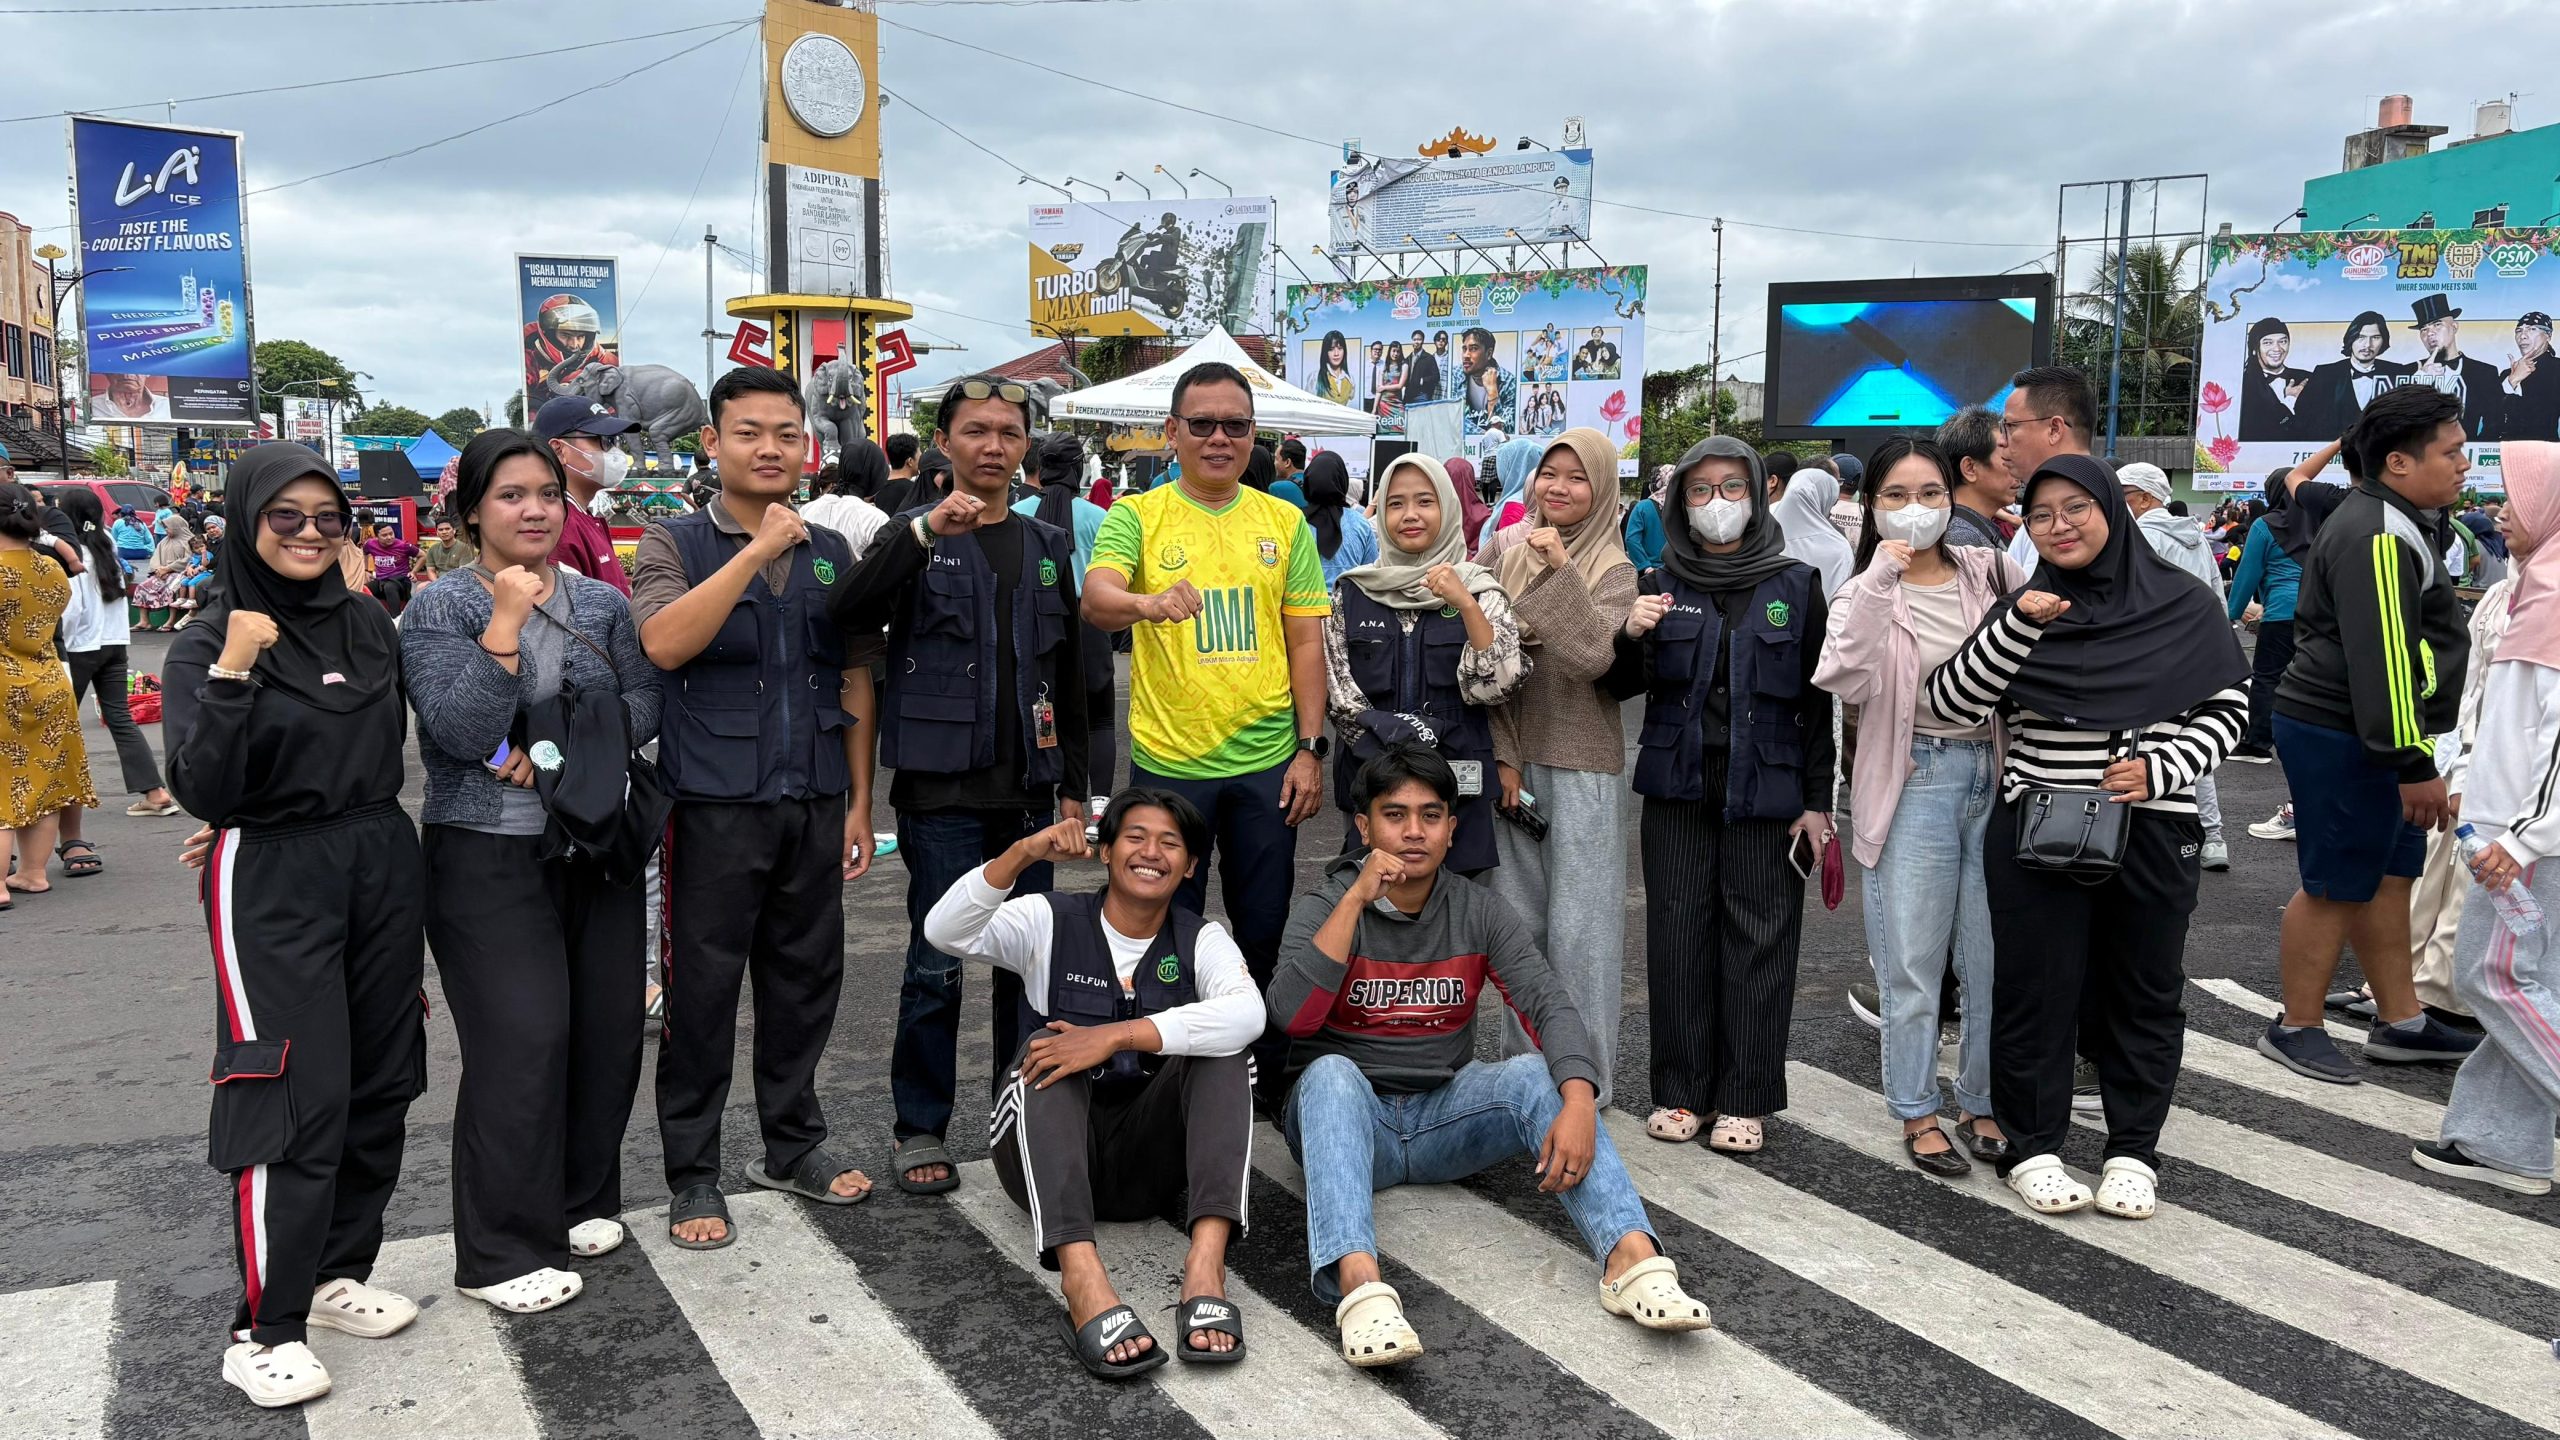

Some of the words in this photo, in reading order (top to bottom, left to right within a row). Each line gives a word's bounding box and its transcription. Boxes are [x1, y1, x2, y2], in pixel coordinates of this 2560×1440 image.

[1481, 165, 1515, 177] BANDAR
[1516, 161, 1555, 174] LAMPUNG
[803, 172, 849, 188] ADIPURA
[169, 193, 202, 205] ICE
[119, 222, 158, 236] TASTE
[161, 218, 188, 233] THE
[91, 235, 152, 251] COOLEST
[154, 232, 233, 251] FLAVORS
[2350, 246, 2382, 266] GMP
[2496, 250, 2531, 263] PSM
[557, 265, 579, 277] TIDAK
[581, 266, 609, 278] PERNAH
[2398, 263, 2437, 279] FEST
[2449, 269, 2474, 279] TMI
[531, 277, 578, 287] MENGKHIANATI
[1035, 269, 1098, 301] TURBO
[2396, 283, 2418, 291] WHERE
[2419, 283, 2440, 291] SOUND
[2441, 283, 2461, 291] MEETS
[2462, 283, 2478, 291] SOUL
[1492, 291, 1516, 302] PSM
[1427, 304, 1452, 318] FEST
[1462, 308, 1478, 317] TMI
[97, 328, 160, 341] PURPLE
[122, 345, 180, 362] MANGO
[1075, 406, 1110, 415] PEMERINTAH
[1111, 407, 1125, 416] KOTA
[2293, 452, 2301, 465] 7
[1668, 604, 1702, 614] AJWA
[1195, 587, 1258, 653] UMA
[1066, 973, 1108, 988] DELFUN
[1347, 977, 1465, 1008] SUPERIOR
[1195, 1303, 1229, 1318] NIKE
[1101, 1311, 1134, 1334] NIKE
